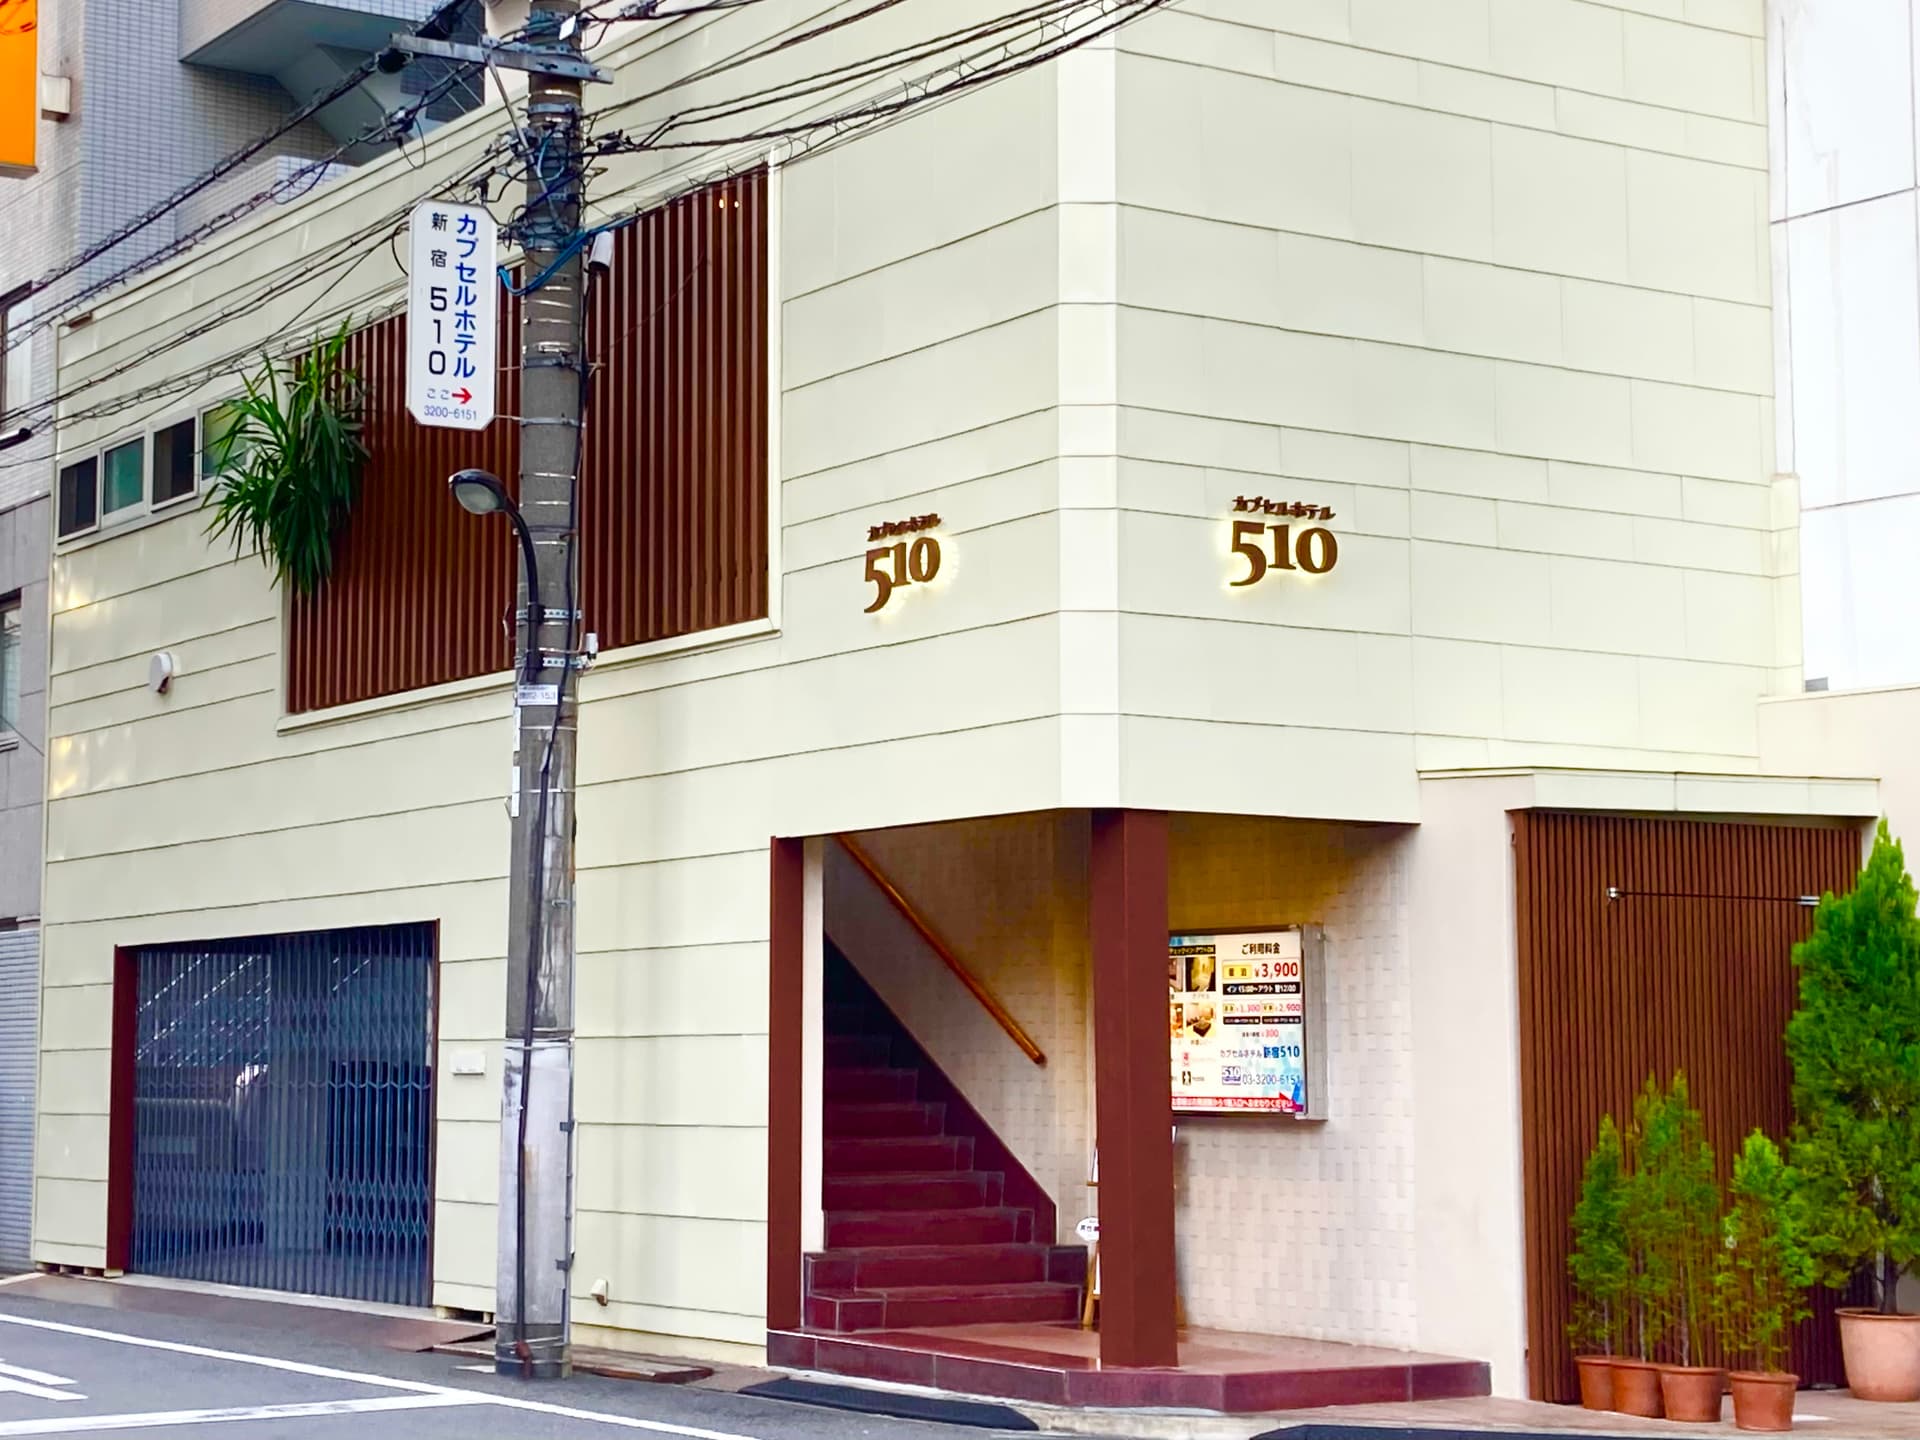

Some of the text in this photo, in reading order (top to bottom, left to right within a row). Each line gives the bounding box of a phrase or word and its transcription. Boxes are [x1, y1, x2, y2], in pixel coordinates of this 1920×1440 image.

[453, 213, 478, 379] カプセルホテル
[423, 404, 477, 421] 3200-6151
[426, 387, 450, 401] ここ
[863, 536, 942, 614] 510
[1229, 520, 1339, 587] 510
